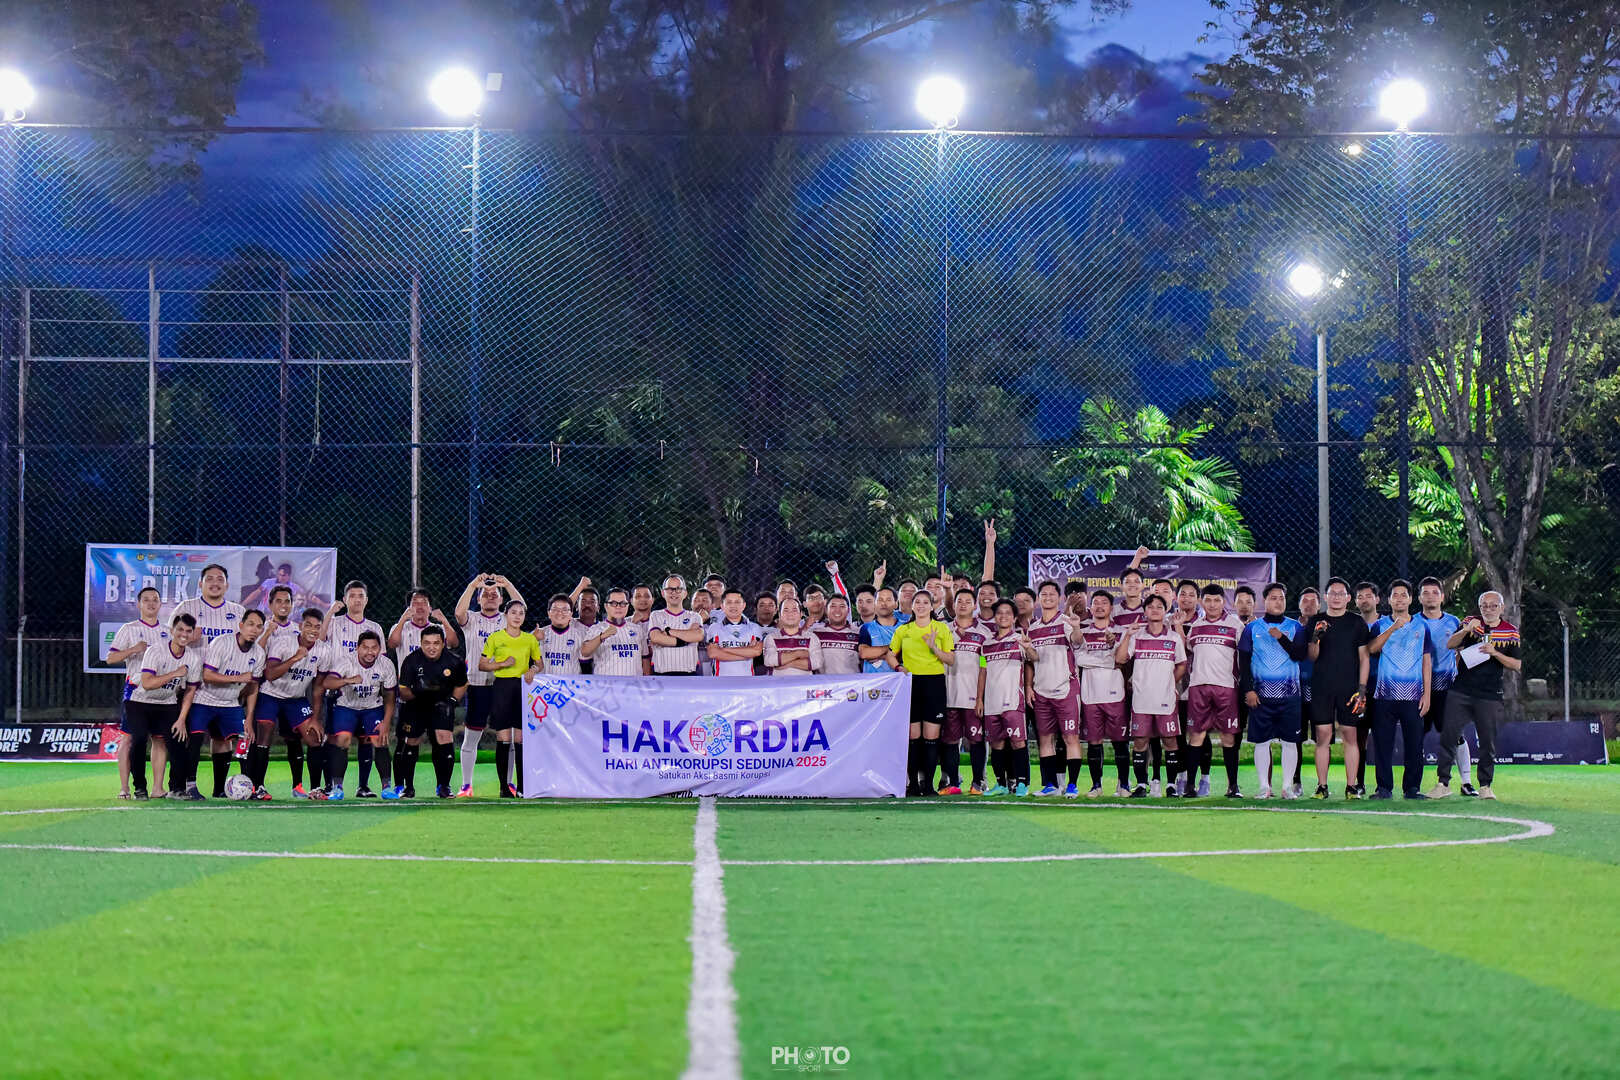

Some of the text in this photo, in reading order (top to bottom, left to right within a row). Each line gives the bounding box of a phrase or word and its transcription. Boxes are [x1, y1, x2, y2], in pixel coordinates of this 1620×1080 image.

[545, 652, 571, 660] KABER
[806, 689, 832, 699] KPK
[1064, 720, 1075, 731] 18
[1166, 721, 1176, 732] 18
[1227, 718, 1238, 729] 14
[40, 728, 101, 744] FARADAYS
[1006, 727, 1020, 738] 94
[50, 742, 89, 752] STORE
[605, 755, 827, 770] HARI ANTIKORUPSI SEDUNIA 2025
[658, 770, 771, 781] Satukan Aksi Basmi Korupsi
